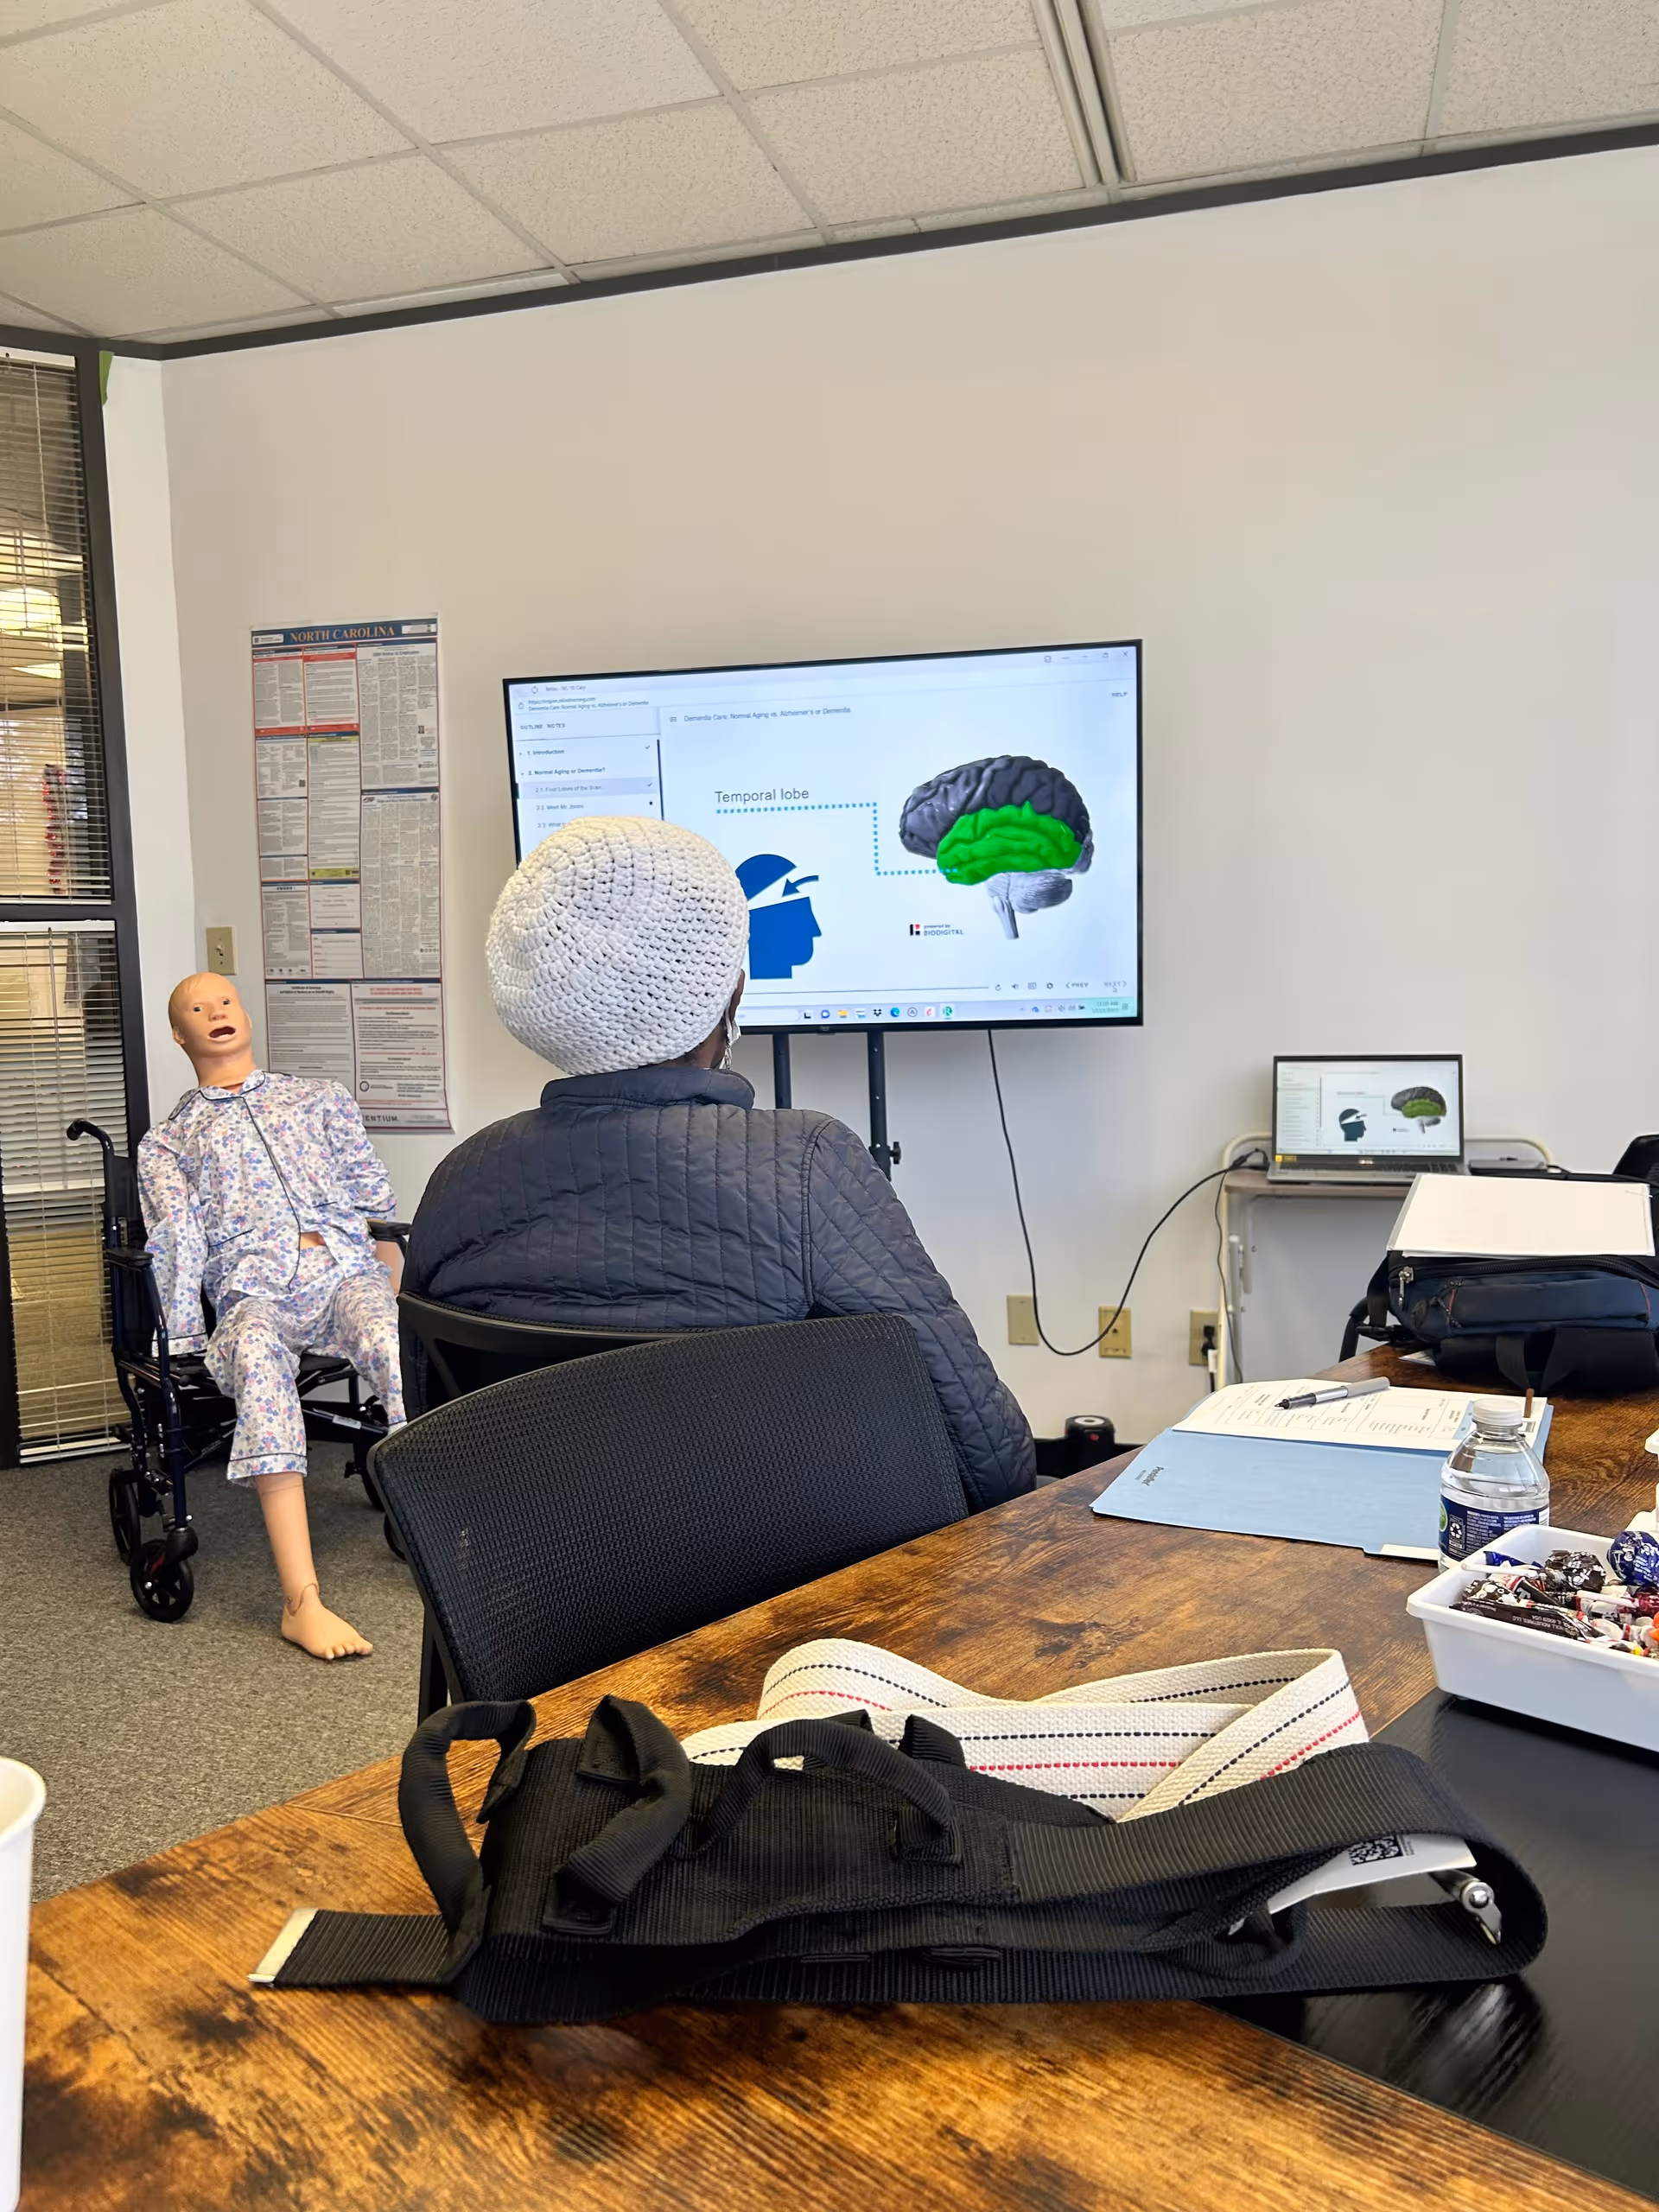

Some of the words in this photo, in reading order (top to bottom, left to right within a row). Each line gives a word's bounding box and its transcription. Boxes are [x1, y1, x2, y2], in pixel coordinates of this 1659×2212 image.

[290, 629, 330, 643] NORTH
[333, 626, 396, 640] CAROLINA
[577, 702, 590, 711] Aging
[752, 712, 769, 721] Aging
[779, 709, 814, 717] Alzheimer's
[715, 788, 777, 804] Temporal
[780, 787, 810, 800] lobe
